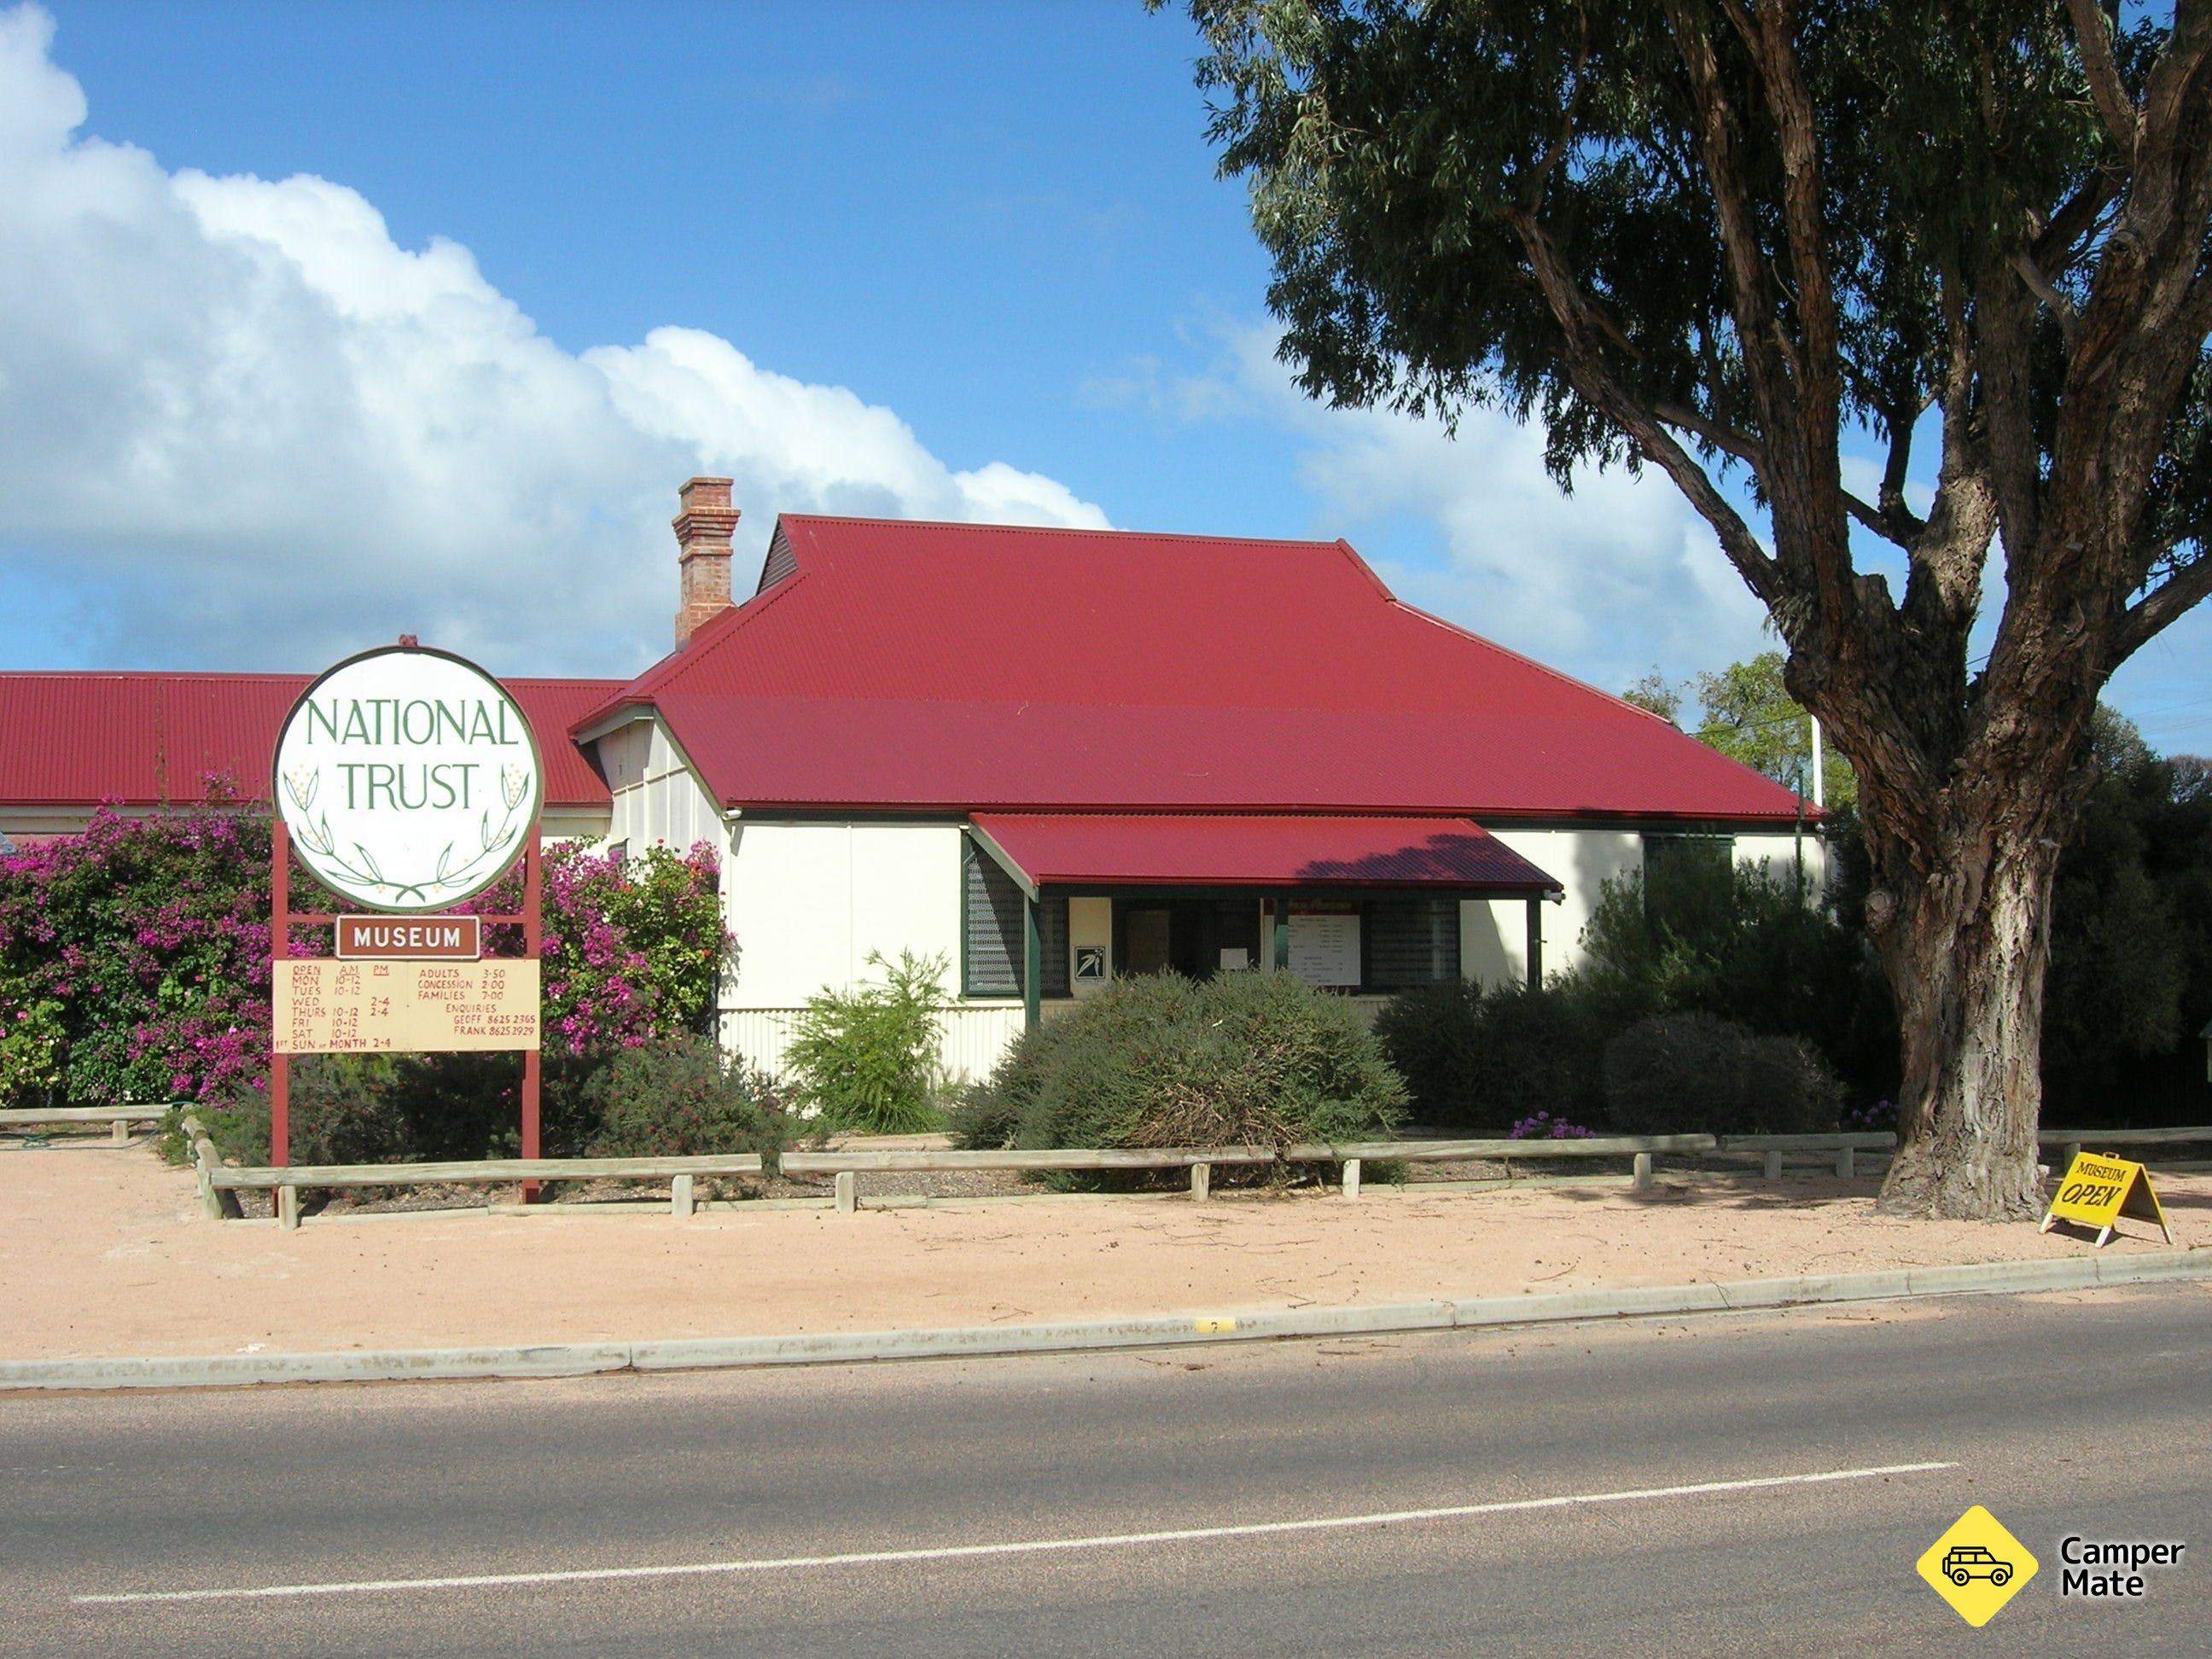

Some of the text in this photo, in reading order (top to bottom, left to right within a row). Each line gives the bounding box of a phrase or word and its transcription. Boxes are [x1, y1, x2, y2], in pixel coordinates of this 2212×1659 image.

[307, 699, 519, 745] NATIONAL
[337, 764, 480, 811] TRUST
[354, 927, 460, 947] MUSEUM
[293, 966, 321, 975] OPEN
[373, 965, 389, 975] PM
[292, 975, 361, 986] MON 10-12
[418, 981, 473, 989] CONCESSION
[294, 987, 361, 995] TUES 10-12
[418, 991, 465, 1000] FAMILIES
[292, 997, 390, 1006] WED 2-4
[292, 1007, 389, 1017] THURS 10-12 2-4
[446, 1004, 497, 1013] ENQUIRIES
[292, 1018, 358, 1027] FRI 10-12
[454, 1015, 482, 1024] GEOFF
[292, 1029, 357, 1039] SAT 10-12
[454, 1027, 486, 1035] FRANK
[293, 1040, 315, 1049] SUN
[330, 1039, 366, 1048] MONTH
[373, 1039, 391, 1047] 2-4
[2076, 1161, 2127, 1182] MUSEUM
[2062, 1184, 2122, 1207] OPEN
